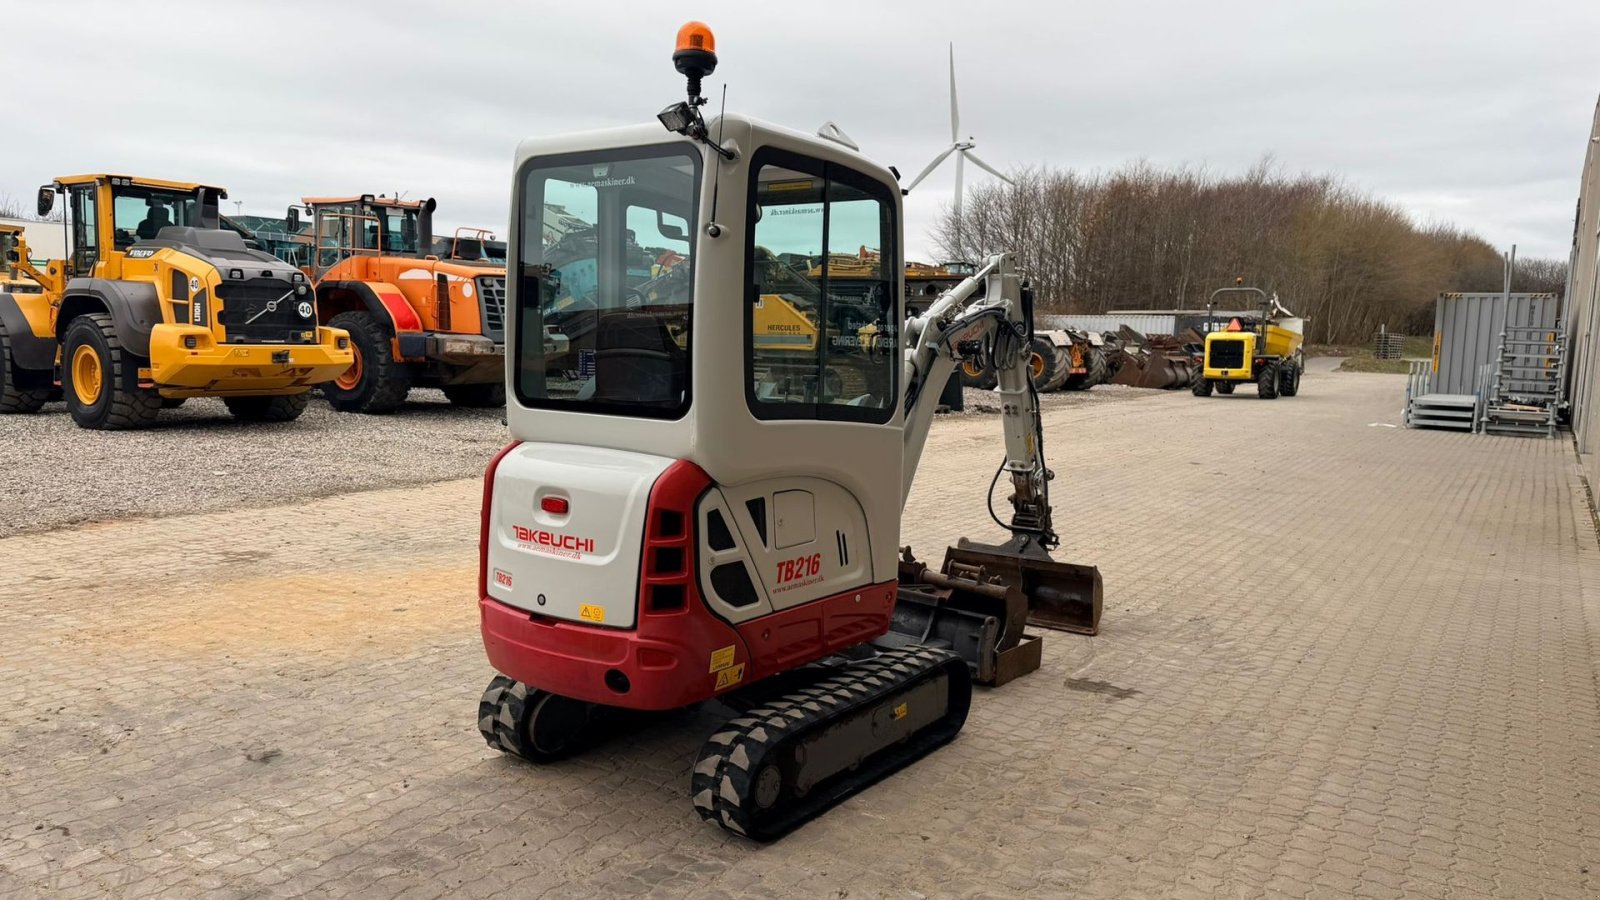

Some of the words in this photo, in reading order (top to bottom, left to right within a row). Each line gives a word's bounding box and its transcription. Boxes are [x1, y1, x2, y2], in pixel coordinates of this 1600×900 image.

[299, 304, 312, 316] 40
[767, 324, 801, 332] HERCULES
[776, 553, 822, 584] TB216
[496, 571, 513, 587] TB216
